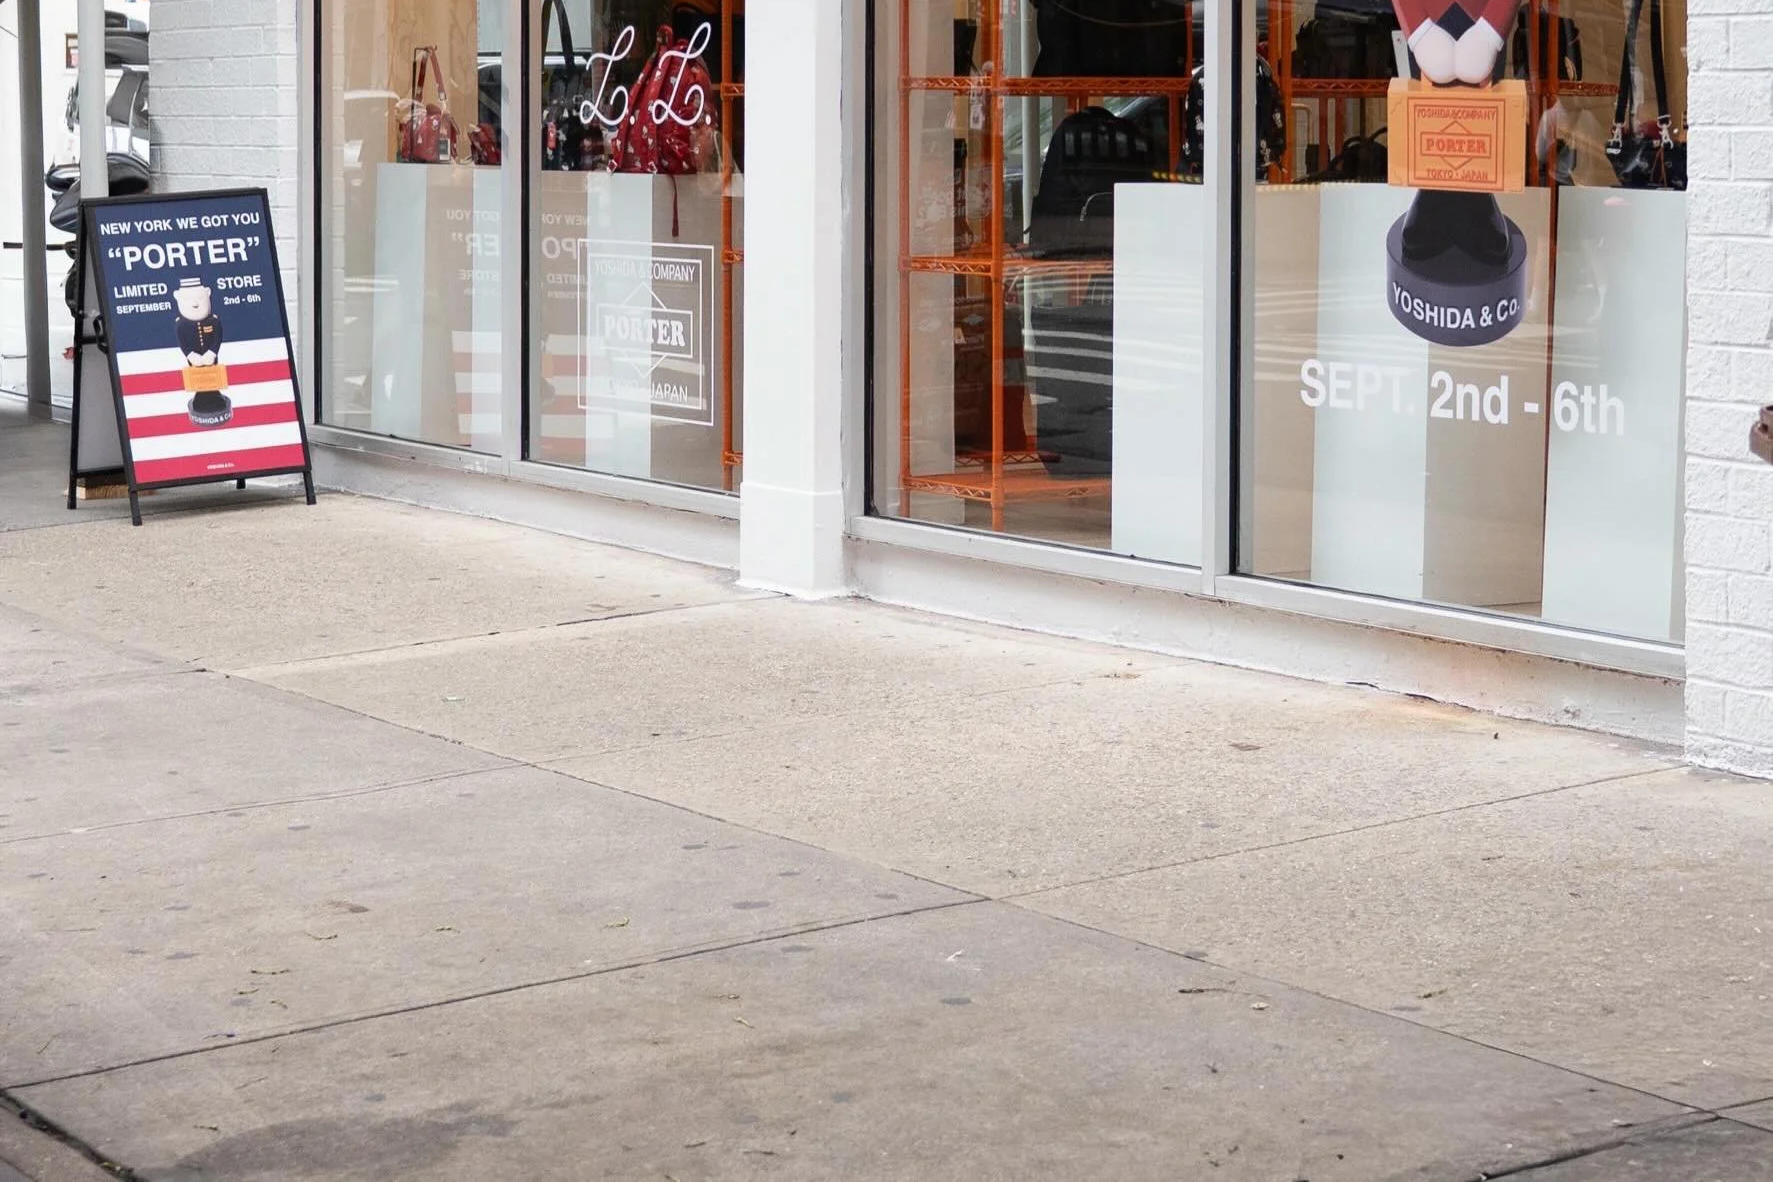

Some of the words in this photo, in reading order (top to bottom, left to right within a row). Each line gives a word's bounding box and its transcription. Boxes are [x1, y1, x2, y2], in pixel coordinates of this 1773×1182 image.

[1424, 138, 1487, 155] PORTER
[1426, 168, 1454, 179] TOKYO
[1460, 169, 1489, 181] JAPAN
[100, 221, 132, 236] NEW
[134, 219, 173, 234] YORK
[176, 217, 199, 230] WE
[201, 214, 229, 229] GOT
[231, 212, 260, 225] YOU
[649, 263, 696, 283] COMPANY
[114, 283, 168, 299] LIMITED
[216, 274, 263, 290] STORE
[116, 301, 172, 315] SEPTEMBER
[223, 295, 240, 306] 2nd
[247, 293, 262, 304] 6th
[1393, 281, 1476, 329] YOSHIDA
[1480, 305, 1493, 327] &
[604, 315, 686, 348] PORTER
[650, 380, 689, 403] JAPAN
[1299, 358, 1415, 414] SEPT.
[1430, 370, 1510, 425] 2nd
[1553, 380, 1626, 436] 6th
